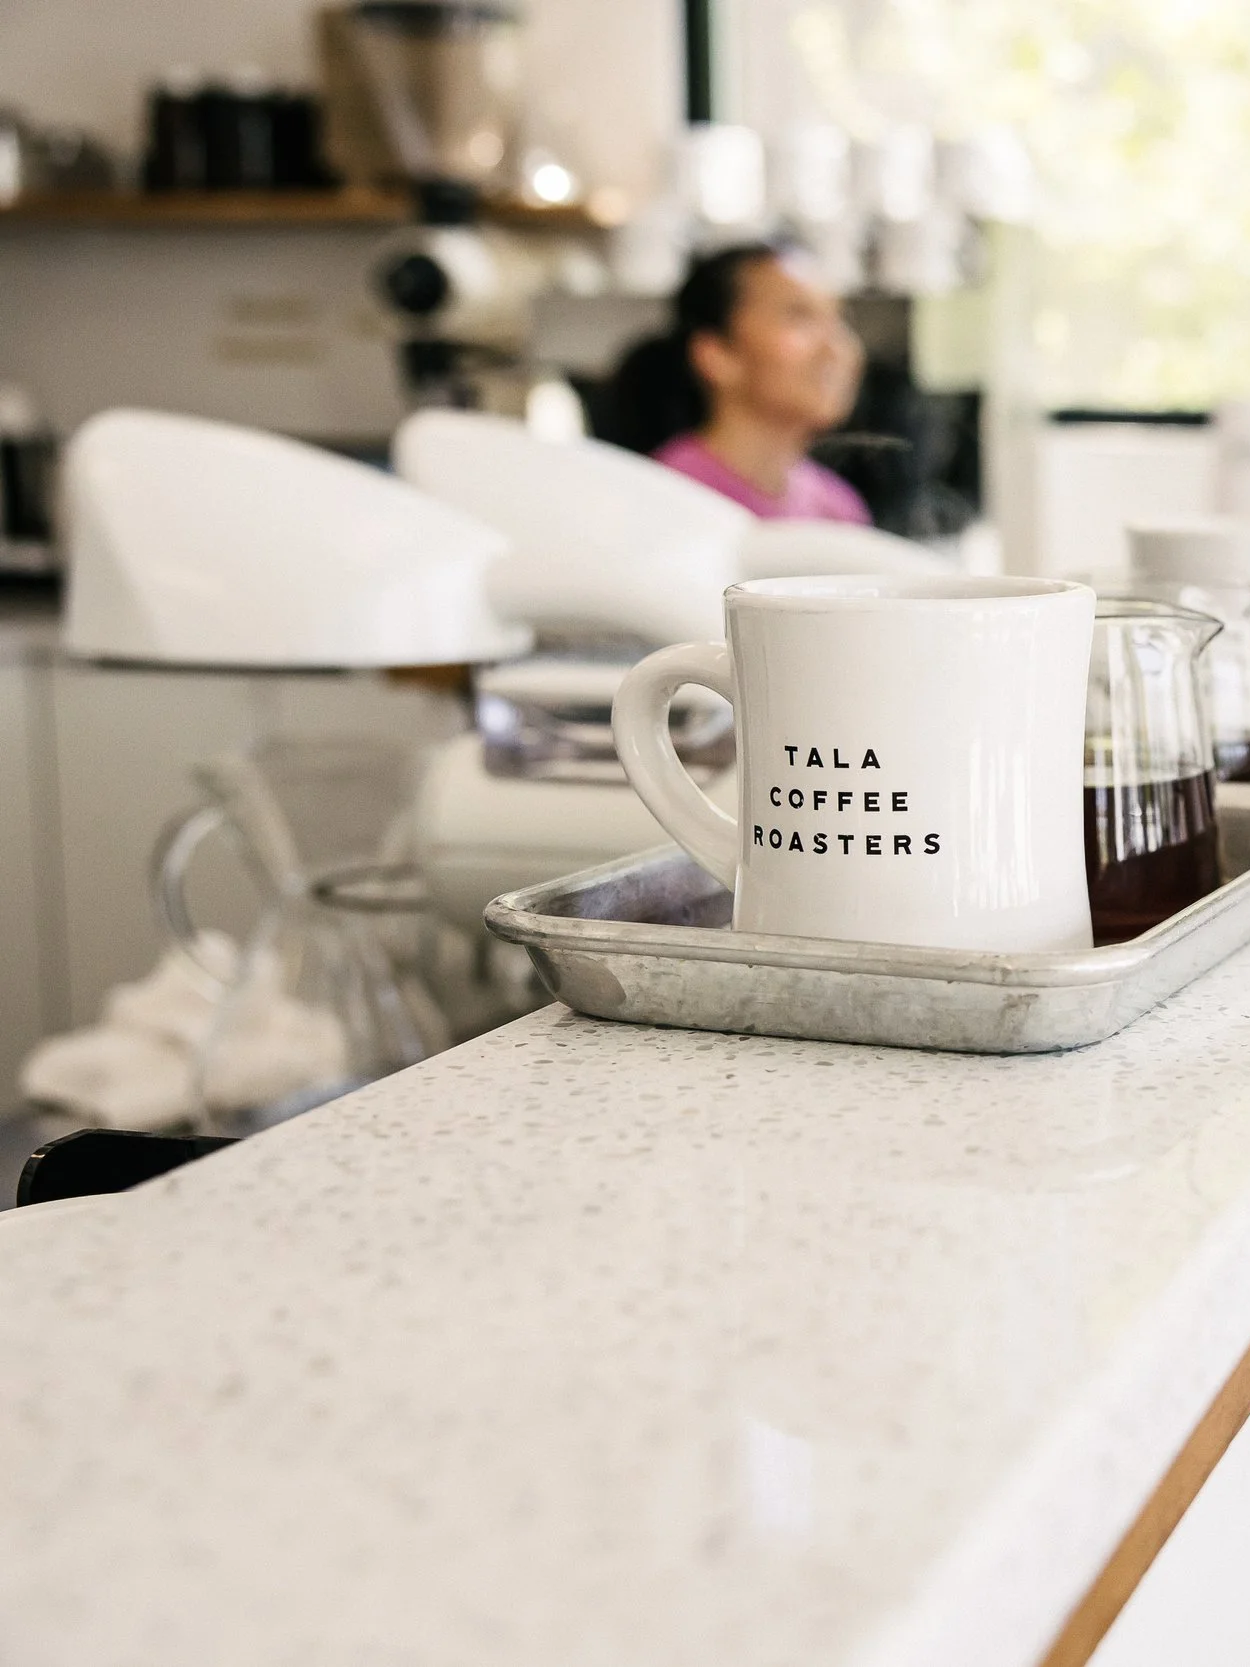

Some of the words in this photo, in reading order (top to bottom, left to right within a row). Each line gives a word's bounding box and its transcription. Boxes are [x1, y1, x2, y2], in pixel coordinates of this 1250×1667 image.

[784, 745, 881, 769] TALA
[769, 786, 908, 812] COFFEE
[753, 824, 941, 856] ROASTERS
